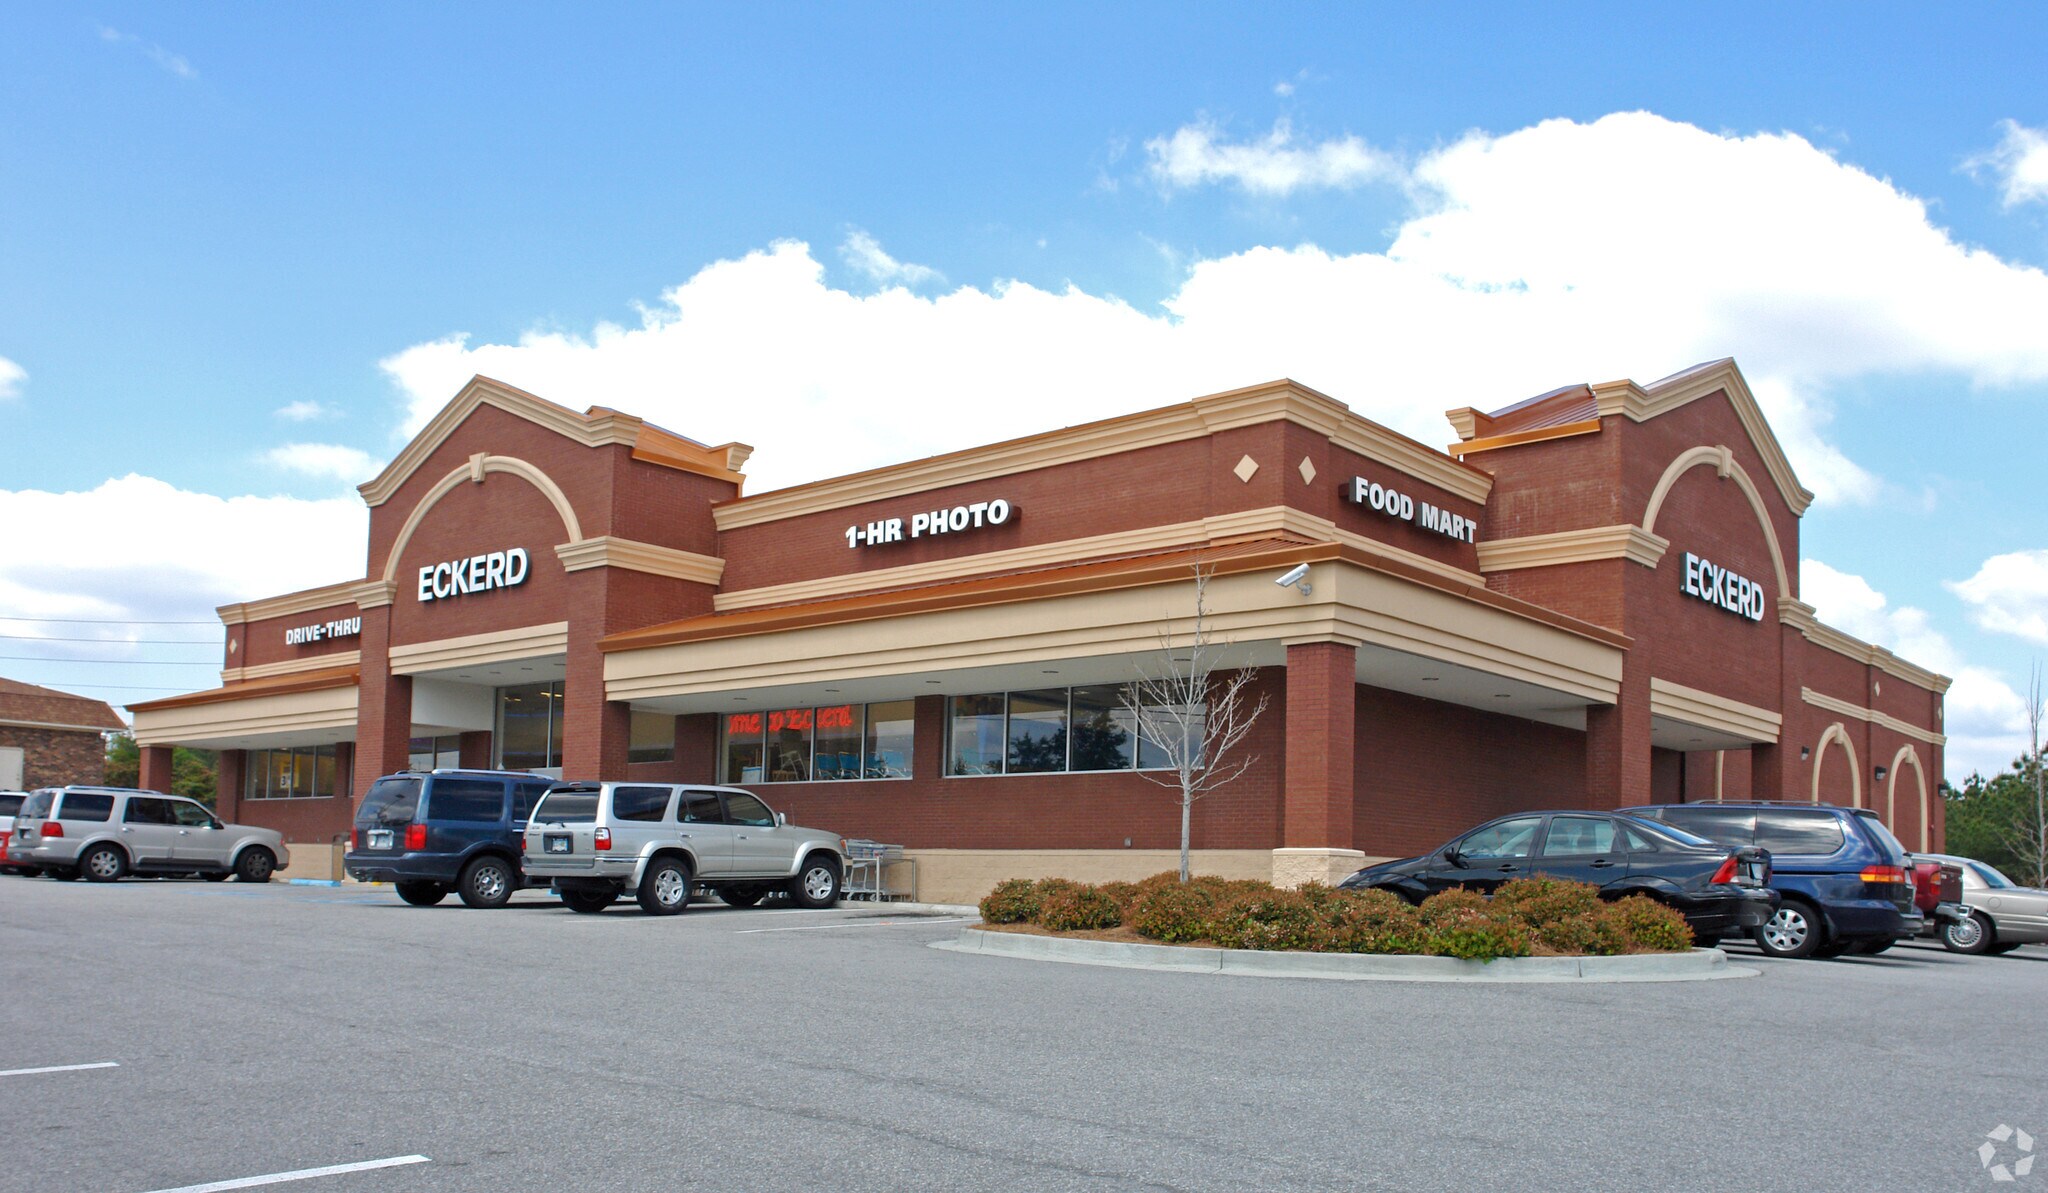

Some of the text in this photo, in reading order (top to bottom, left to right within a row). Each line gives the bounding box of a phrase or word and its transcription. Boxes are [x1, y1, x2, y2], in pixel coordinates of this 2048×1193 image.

[845, 498, 1010, 549] 1-HR PHOTO
[1355, 475, 1477, 544] FOOD MART
[417, 547, 528, 602] ECKERD
[1685, 551, 1765, 622] ECKERD
[285, 616, 361, 646] DRIVE-THRU
